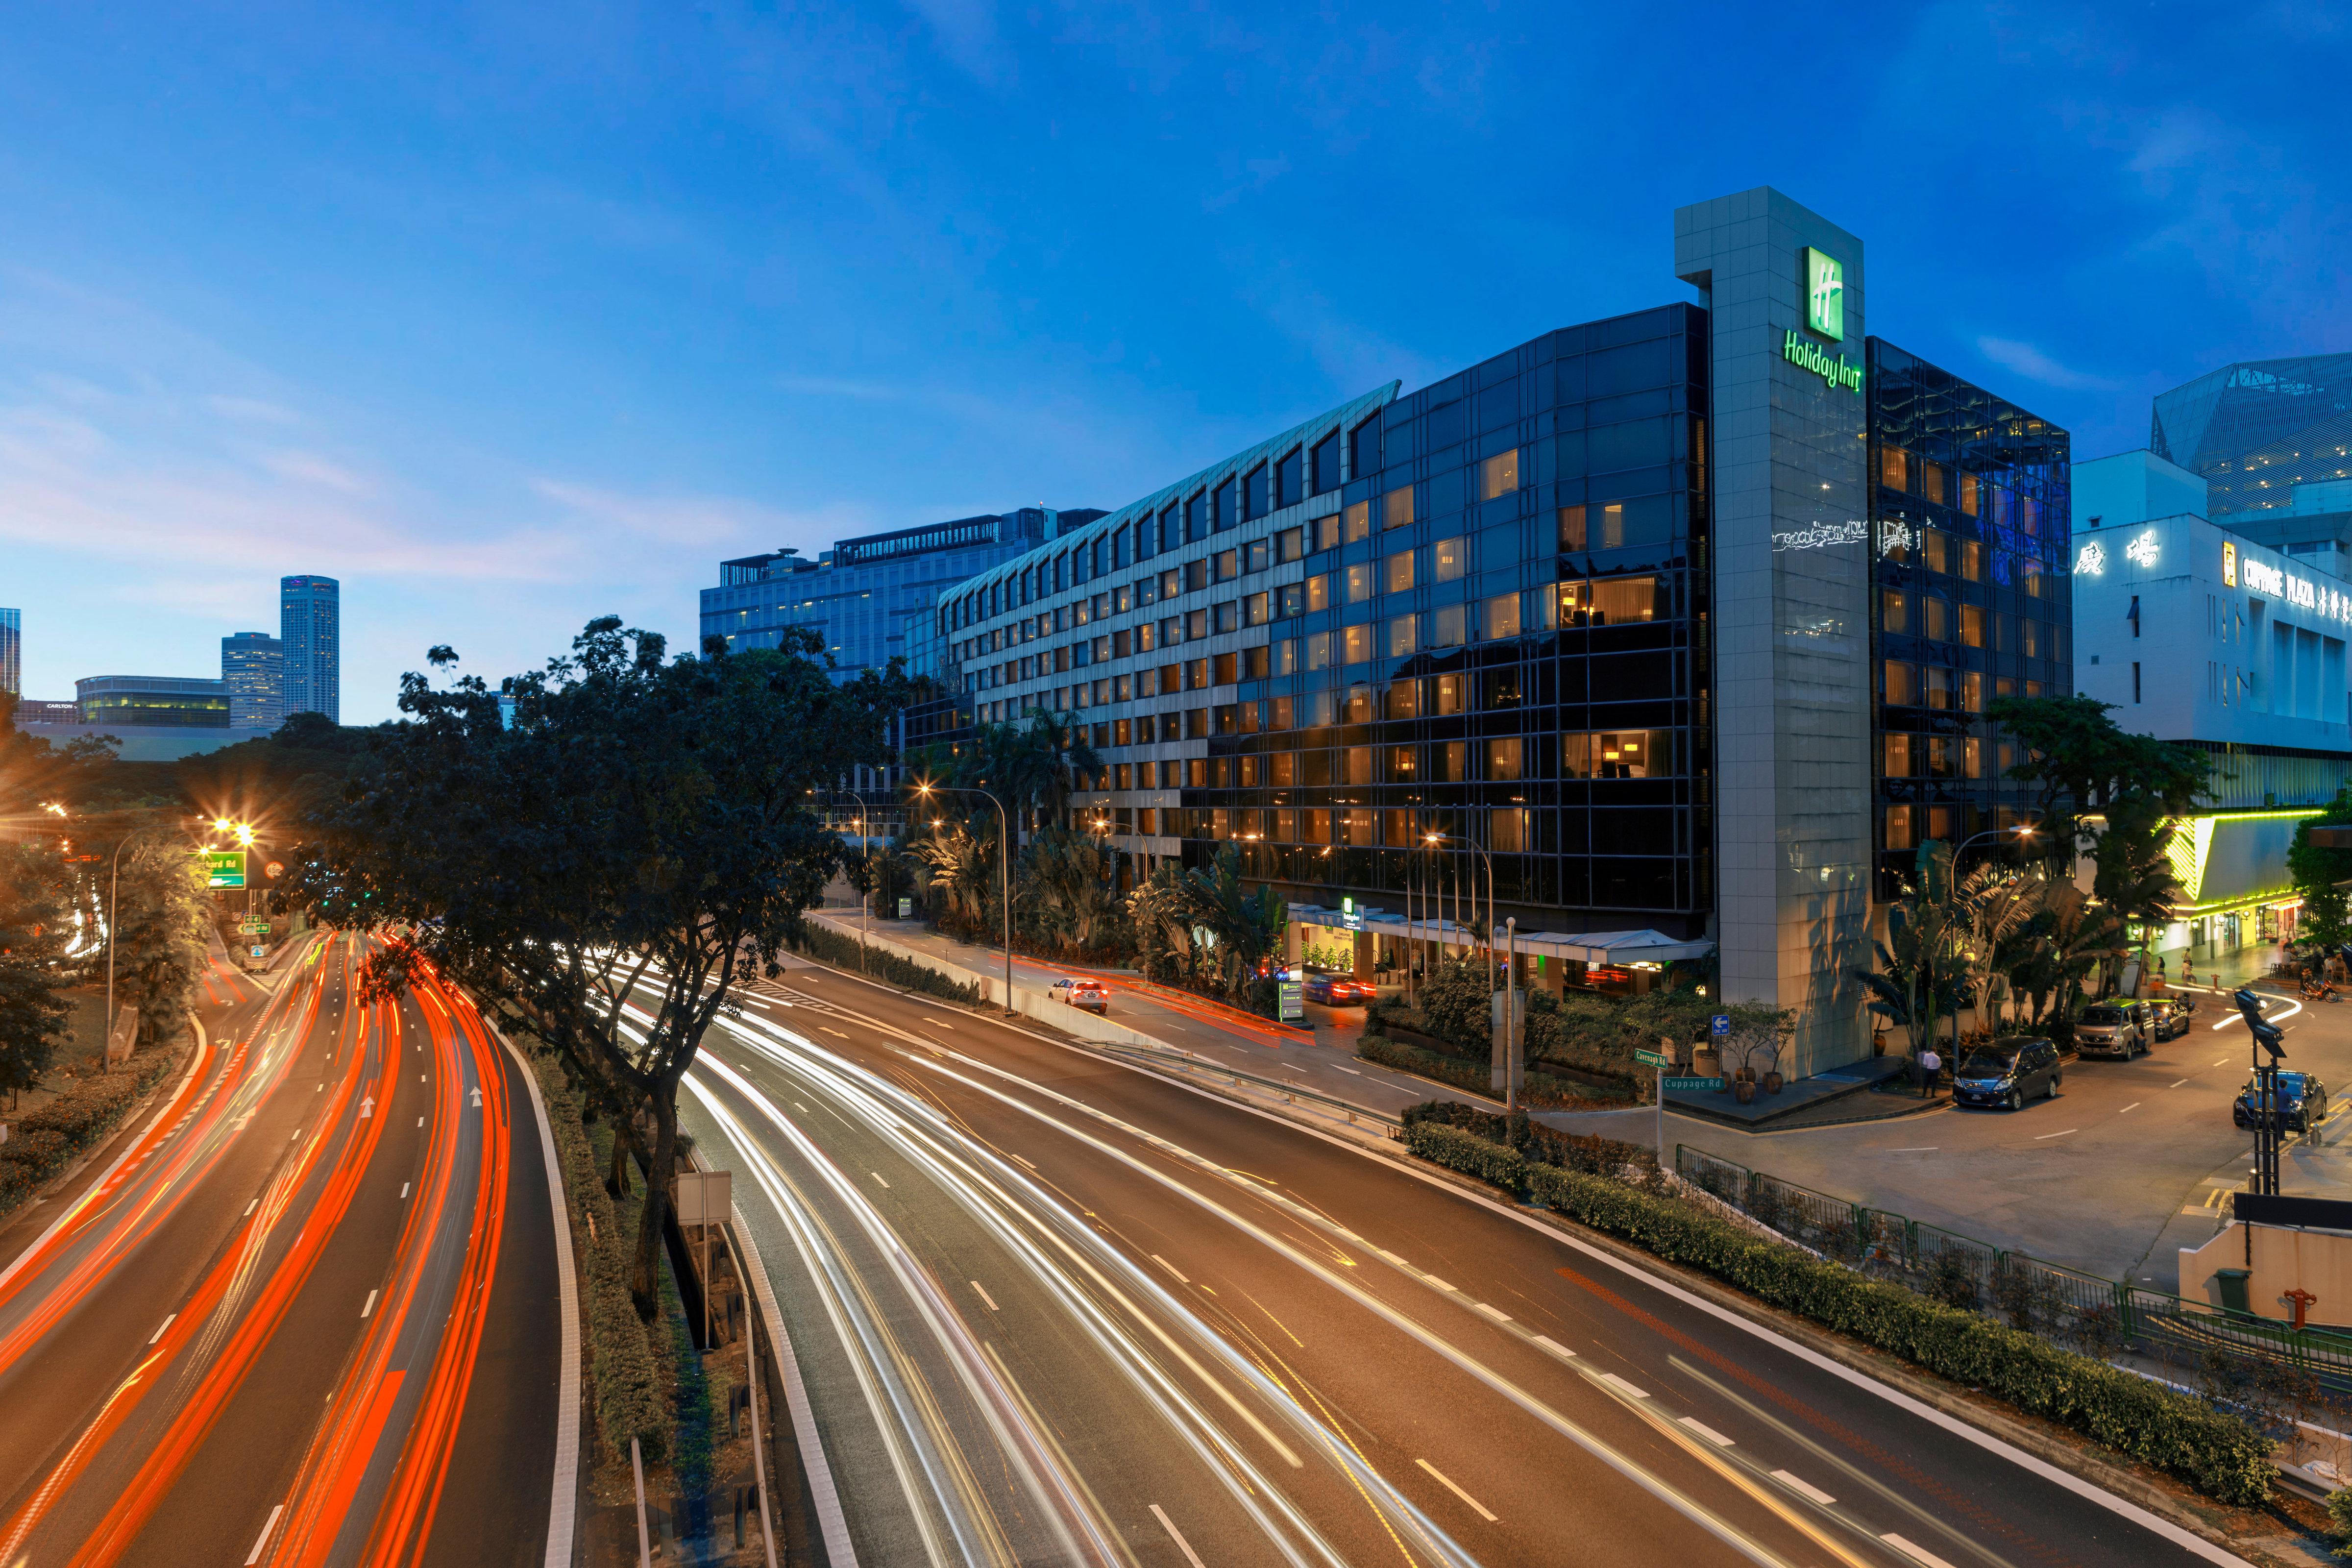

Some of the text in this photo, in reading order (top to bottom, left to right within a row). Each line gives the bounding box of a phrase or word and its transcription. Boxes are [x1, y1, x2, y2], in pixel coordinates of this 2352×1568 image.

[1785, 329, 1859, 389] Holiday Inn
[2286, 575, 2315, 609] PLAZA
[1636, 1051, 1666, 1066] Cavenagh Rd
[1665, 1079, 1720, 1089] Cuppage Rd
